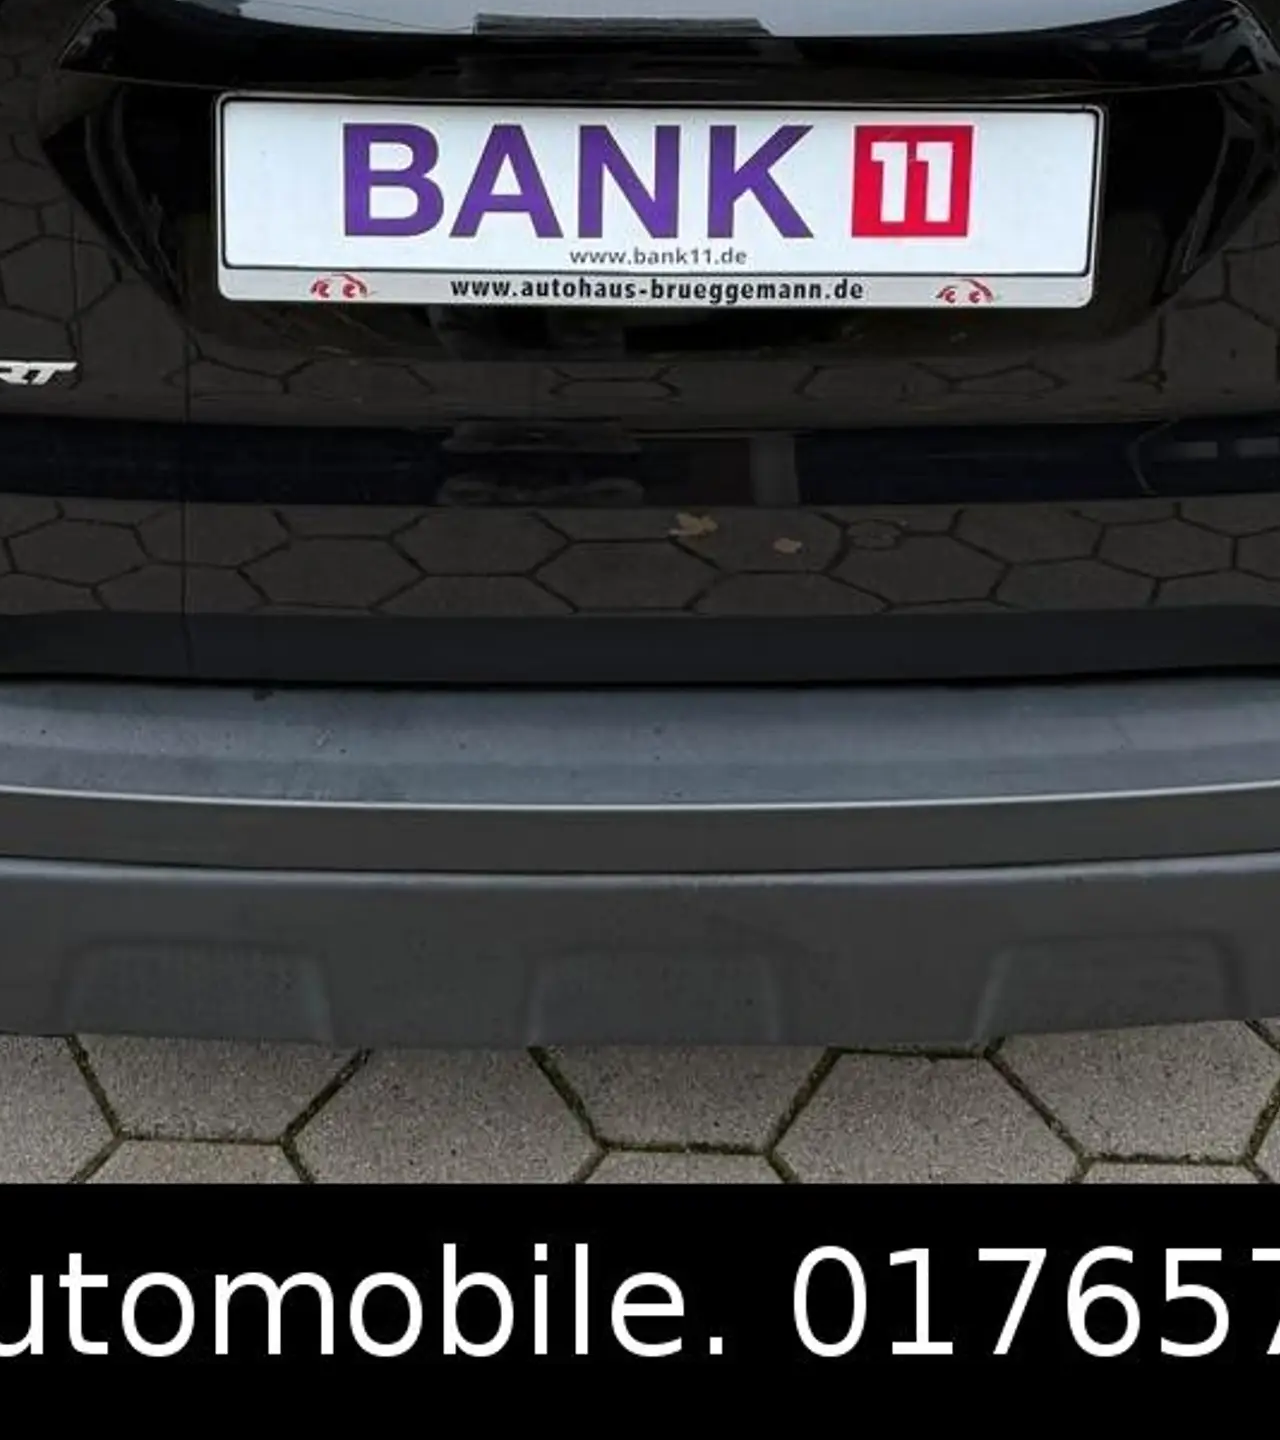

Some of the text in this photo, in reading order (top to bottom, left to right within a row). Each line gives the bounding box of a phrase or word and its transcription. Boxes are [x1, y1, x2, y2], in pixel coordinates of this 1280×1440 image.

[342, 123, 954, 240] BANK 11
[569, 246, 748, 266] www.bank11.de
[450, 276, 865, 305] www.autohaus-brueggemann.de
